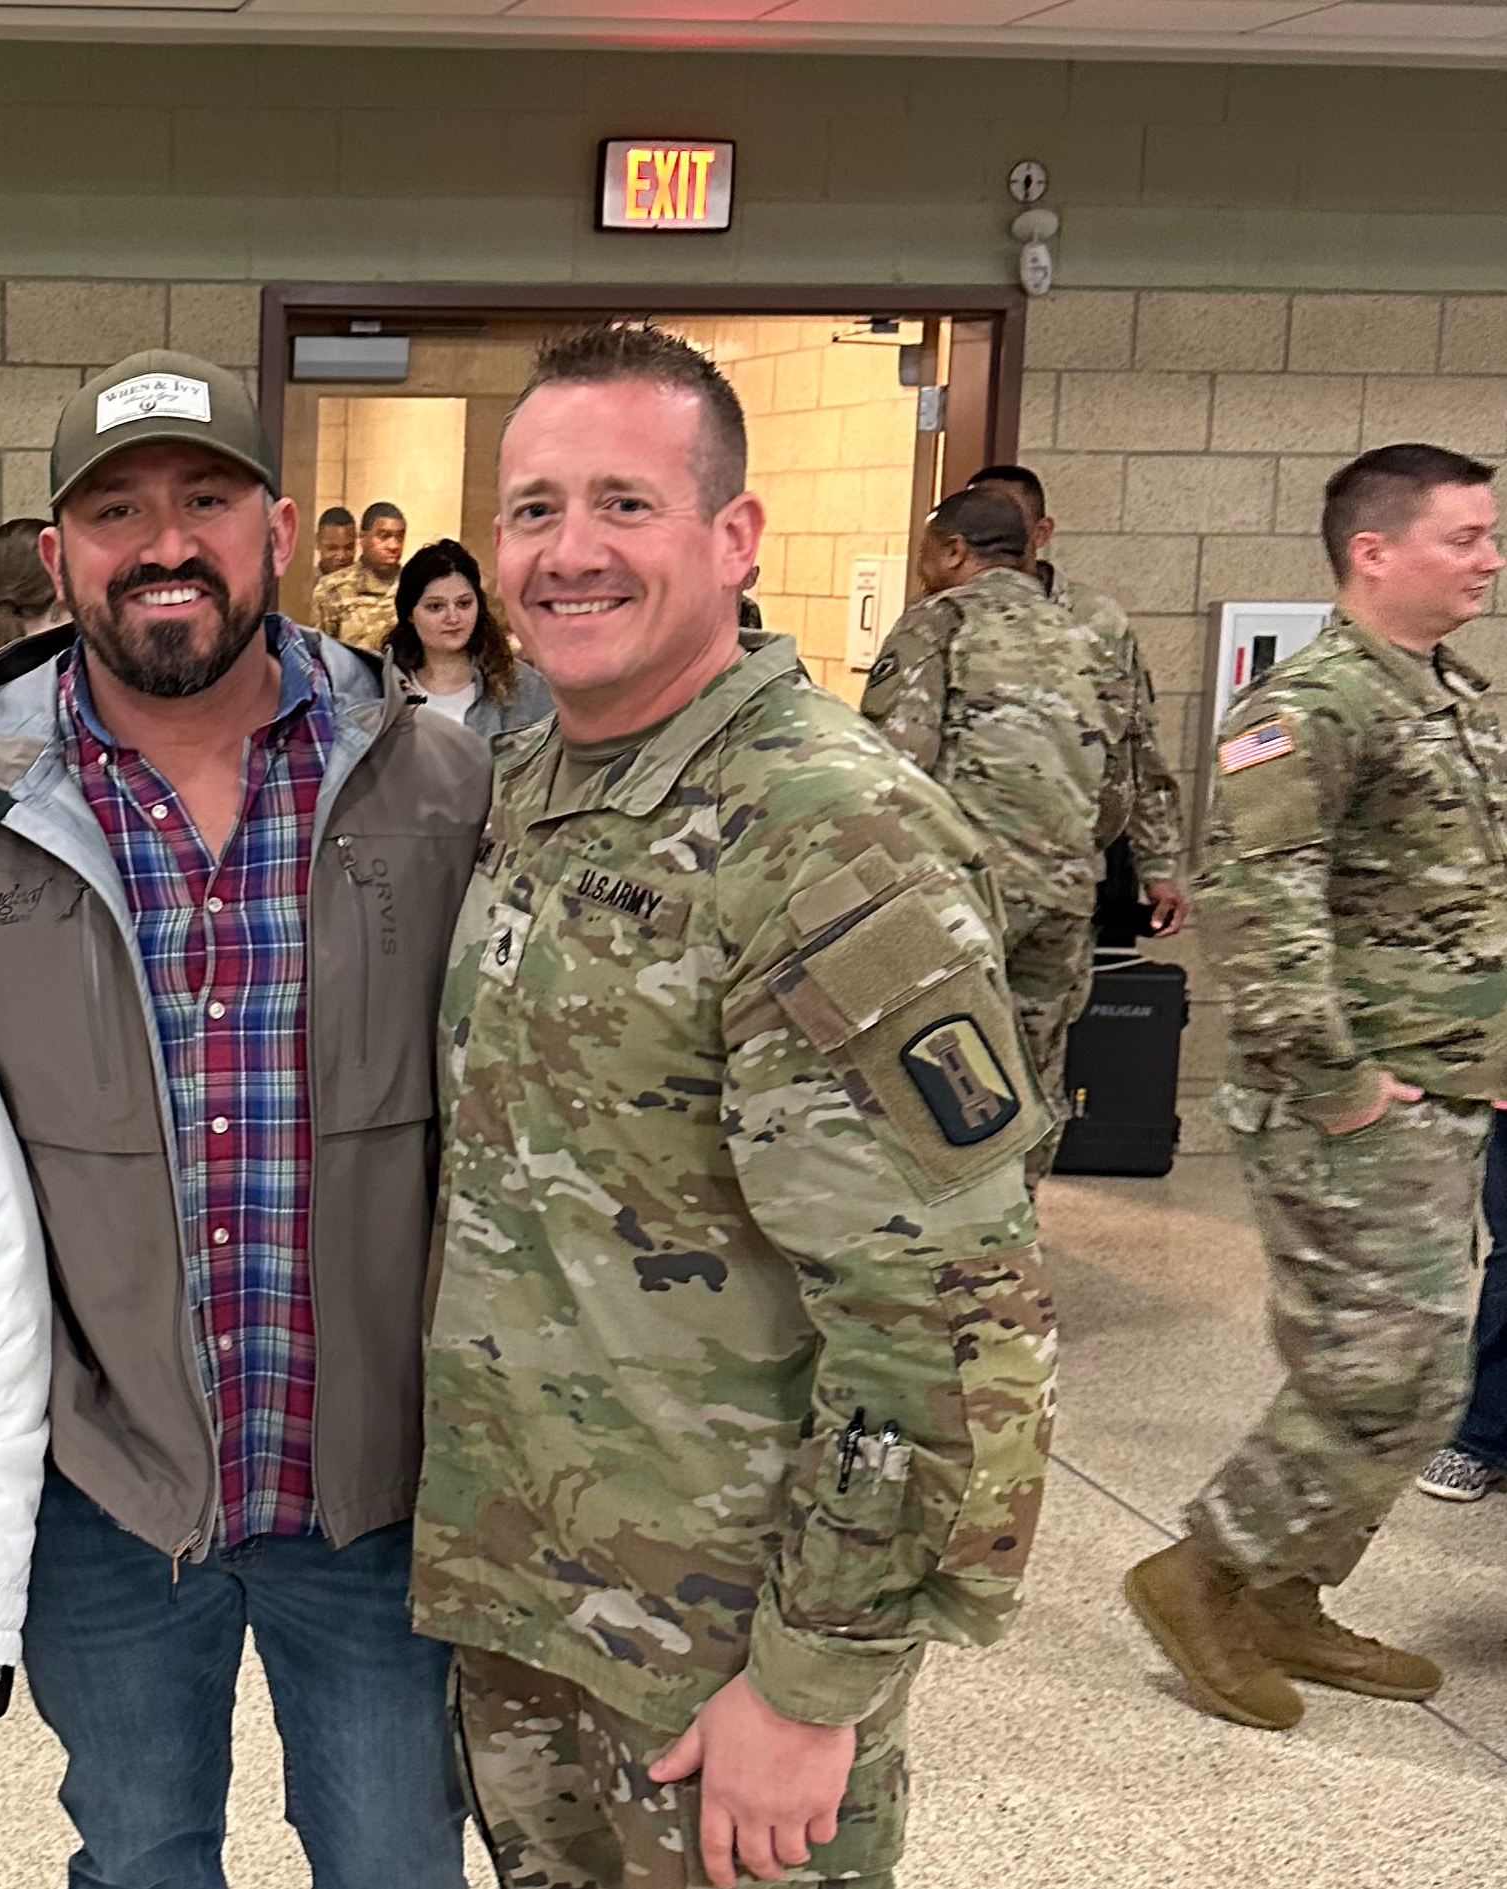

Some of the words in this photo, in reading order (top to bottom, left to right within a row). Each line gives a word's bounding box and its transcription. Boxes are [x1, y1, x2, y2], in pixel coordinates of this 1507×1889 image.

[624, 148, 716, 220] EXIT
[372, 858, 397, 955] ORVIS
[1089, 1003, 1154, 1017] PELICAN
